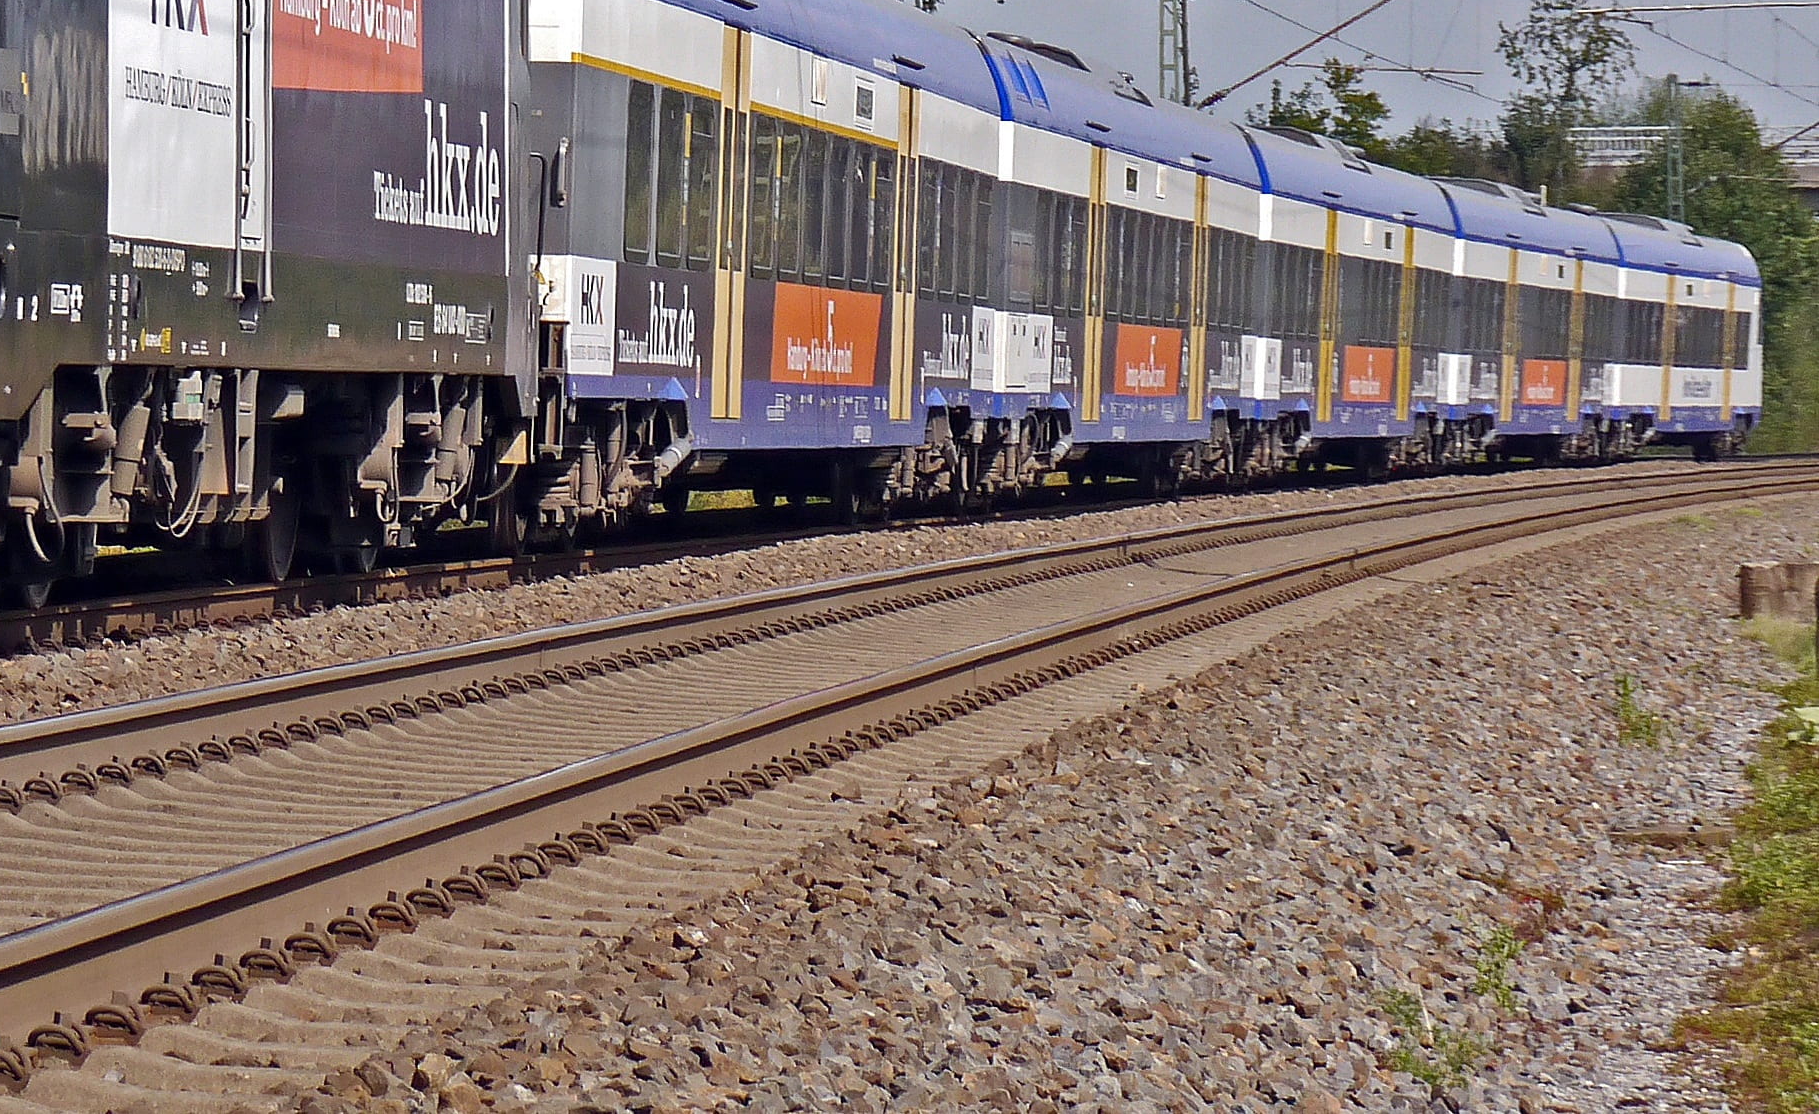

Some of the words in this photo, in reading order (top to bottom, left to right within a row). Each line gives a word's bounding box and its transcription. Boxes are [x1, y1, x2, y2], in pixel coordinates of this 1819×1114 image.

[374, 170, 409, 224] Tickets
[424, 98, 500, 237] hkx.de
[648, 281, 695, 368] hkx.de
